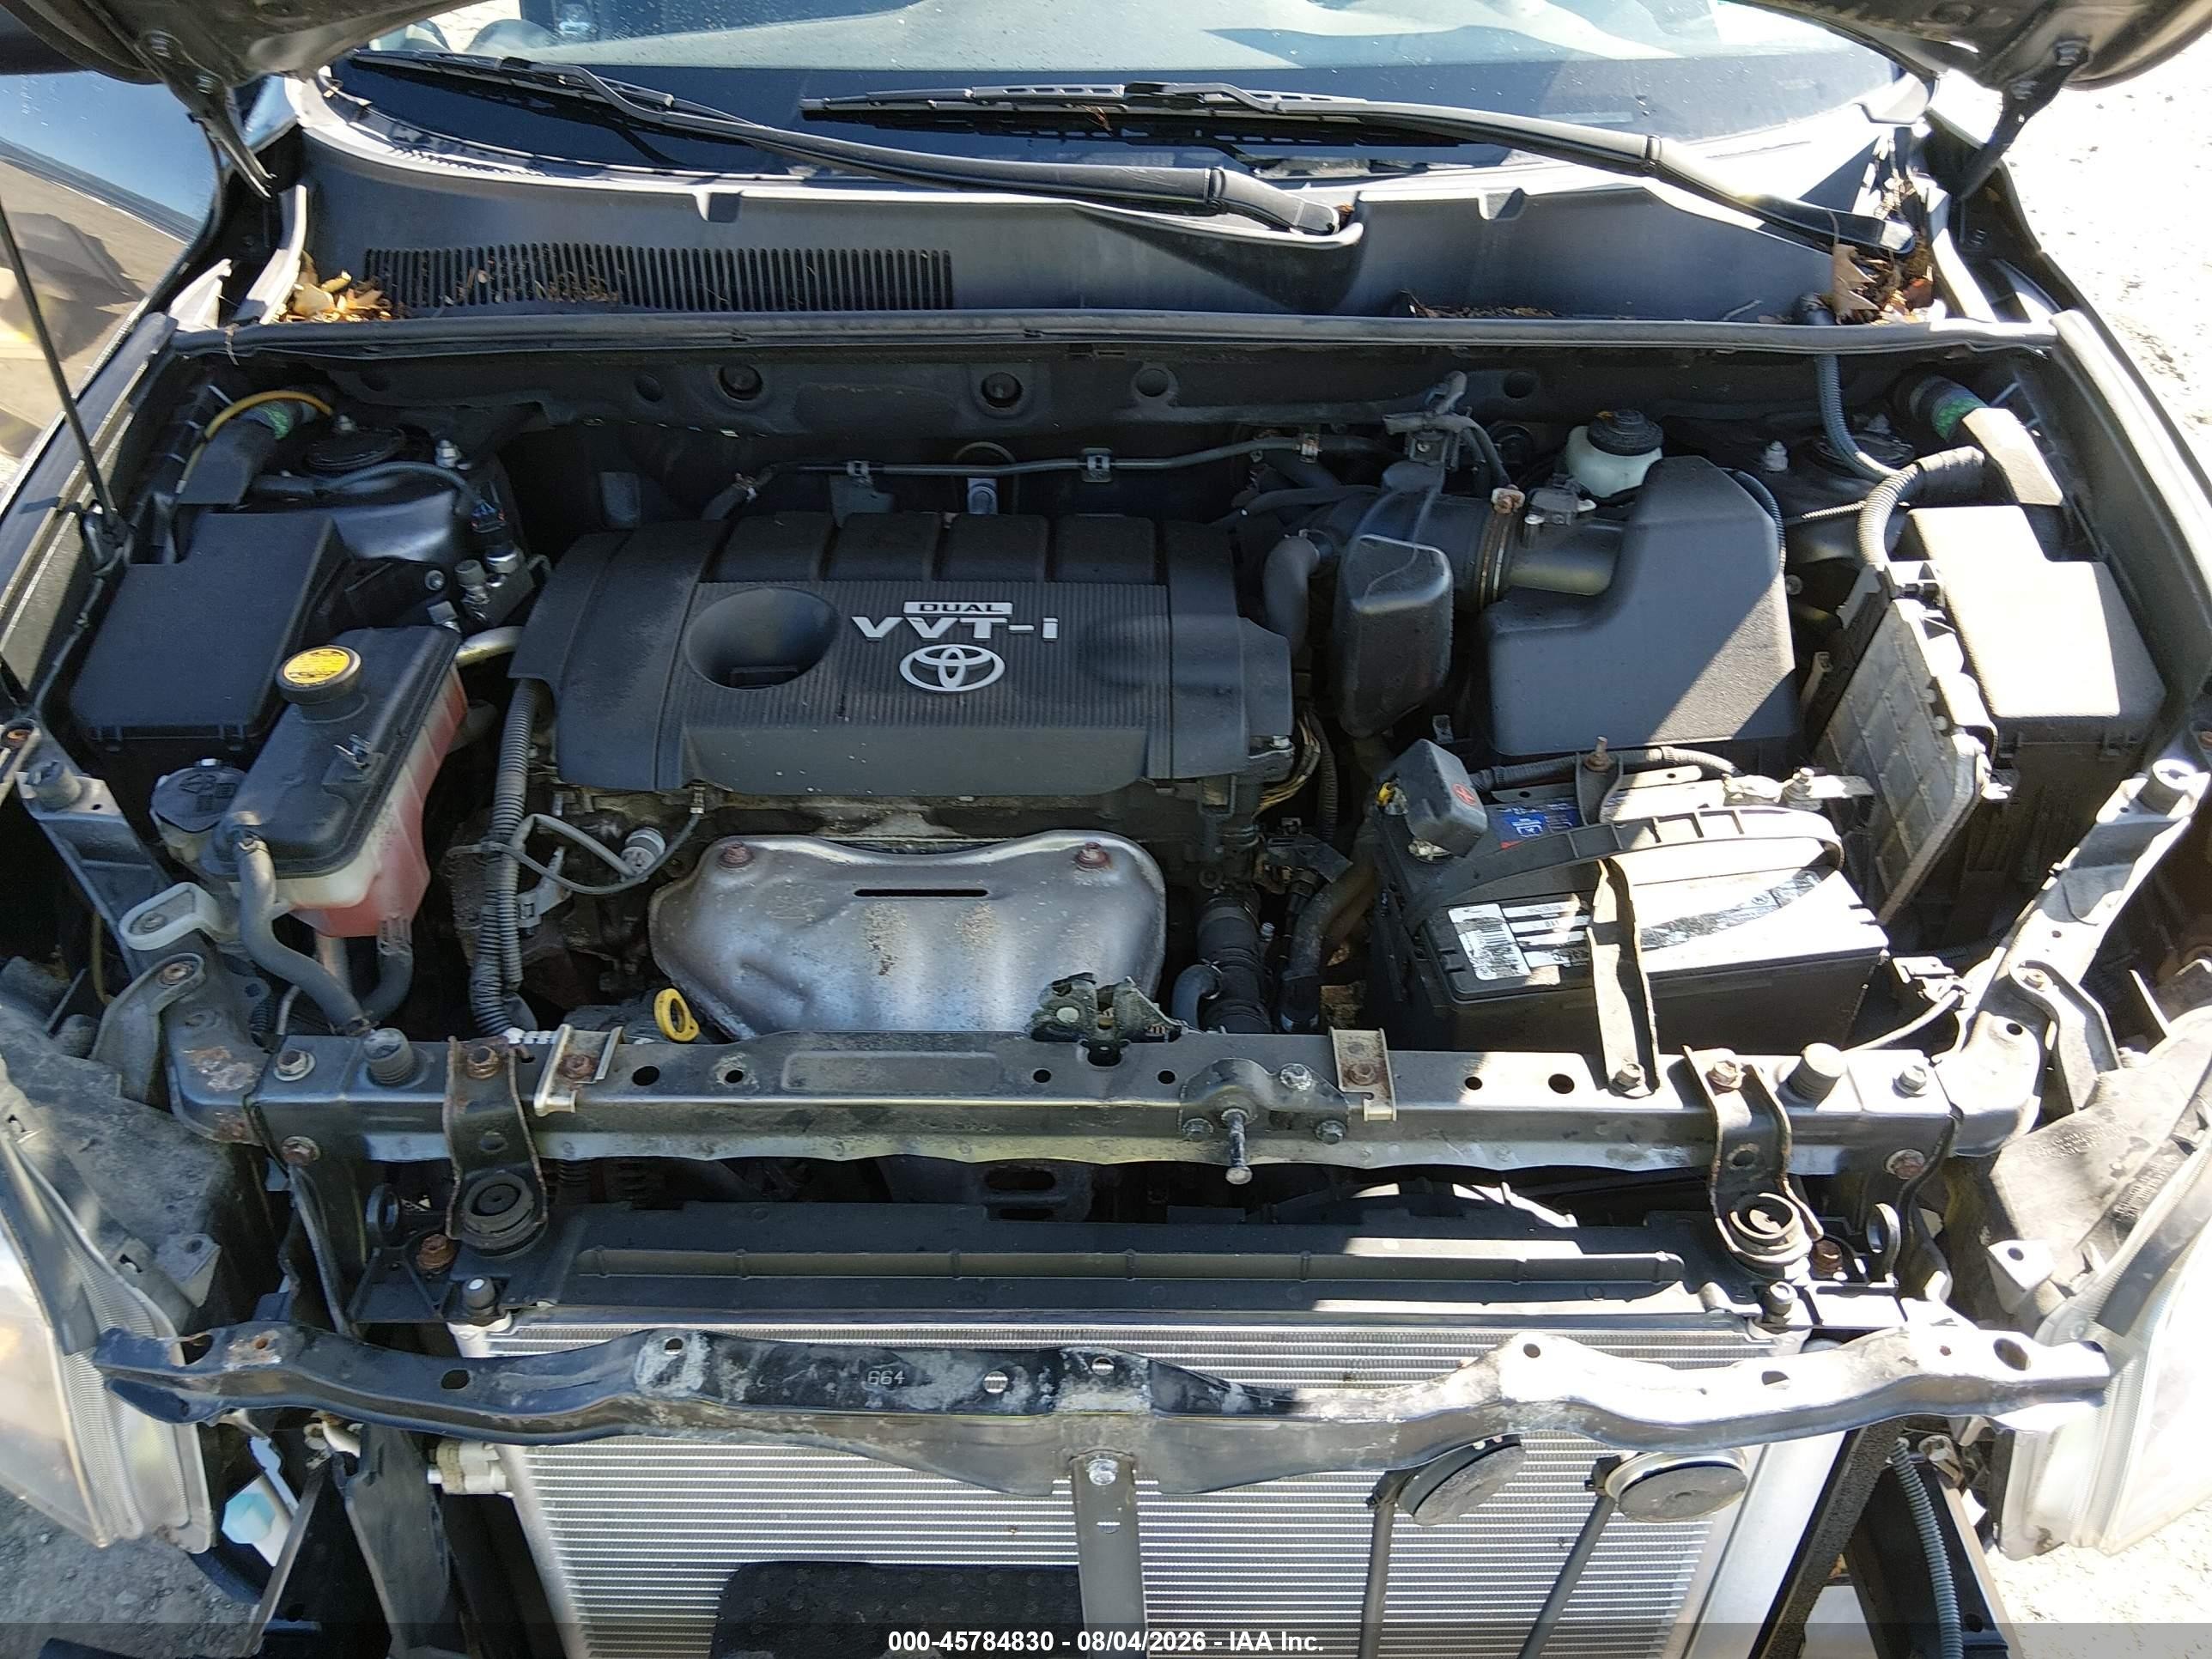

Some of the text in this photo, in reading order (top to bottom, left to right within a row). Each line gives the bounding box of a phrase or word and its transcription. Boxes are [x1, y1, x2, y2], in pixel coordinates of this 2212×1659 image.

[920, 604, 1004, 612] DUAL
[851, 617, 1059, 639] VVT-i
[867, 1370, 905, 1385] 664
